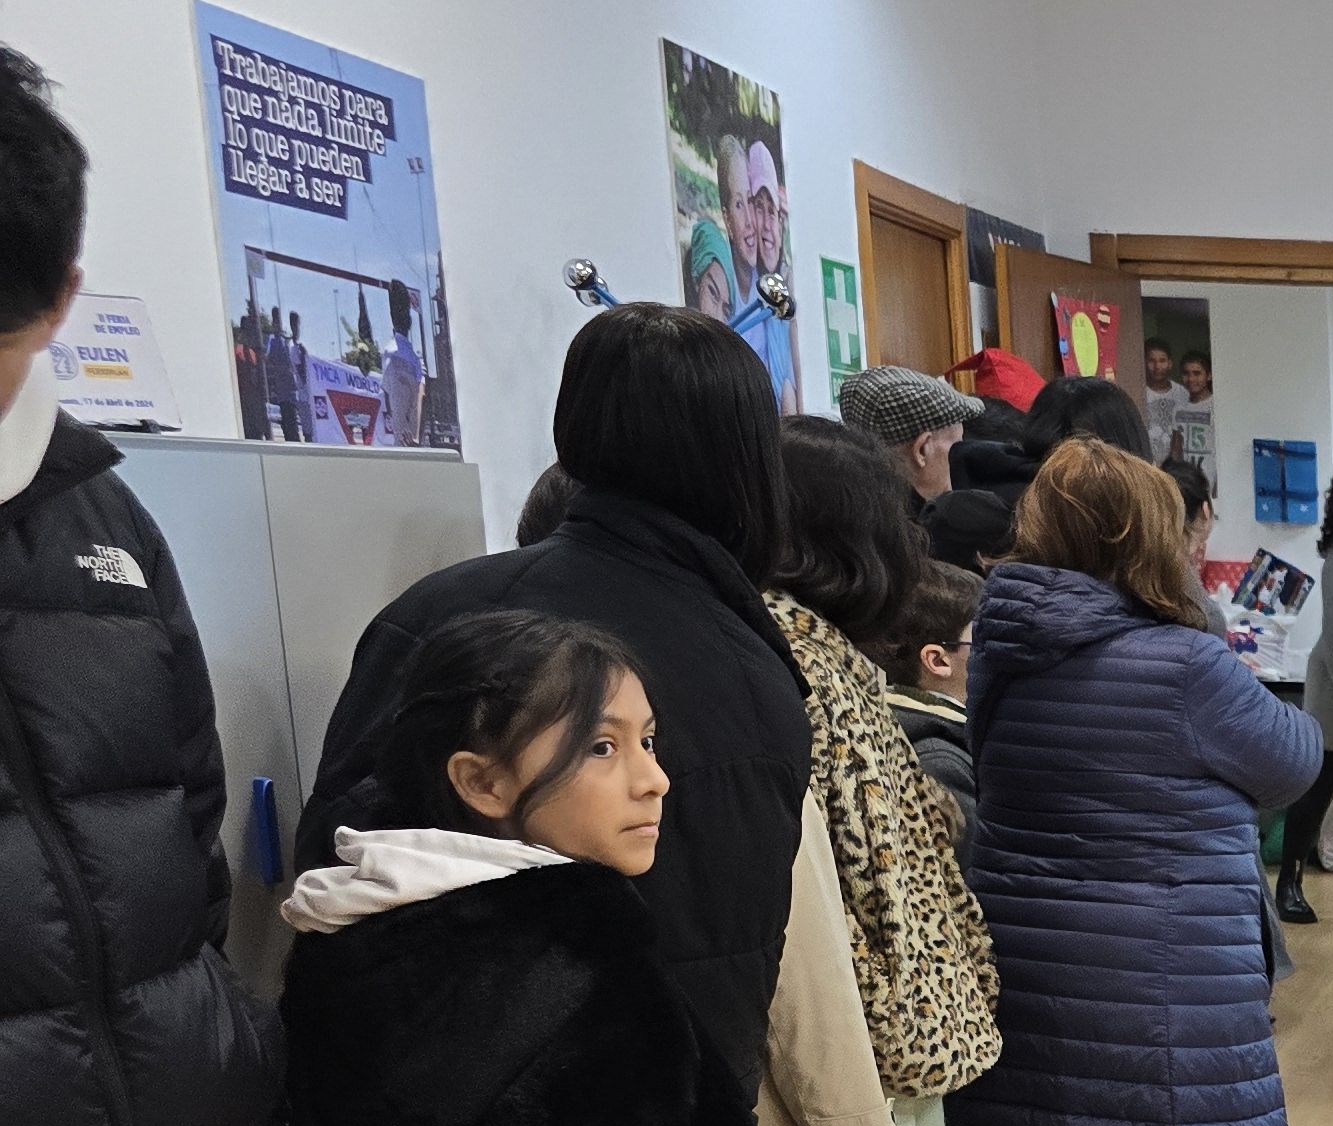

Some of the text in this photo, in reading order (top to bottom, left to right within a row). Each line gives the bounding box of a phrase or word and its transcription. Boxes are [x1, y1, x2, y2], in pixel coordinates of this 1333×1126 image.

[215, 40, 388, 125] Trabajamos para
[221, 84, 386, 154] que nada limite
[224, 111, 366, 182] lo que pueden
[228, 147, 344, 207] llegar a ser
[105, 313, 132, 325] FERIA
[94, 324, 141, 336] DE EMPLEO
[77, 346, 129, 363] EULEN
[312, 363, 381, 394] YMCA WORLD
[92, 544, 120, 560] THE
[75, 555, 125, 572] NORTH
[94, 569, 129, 583] FACE
